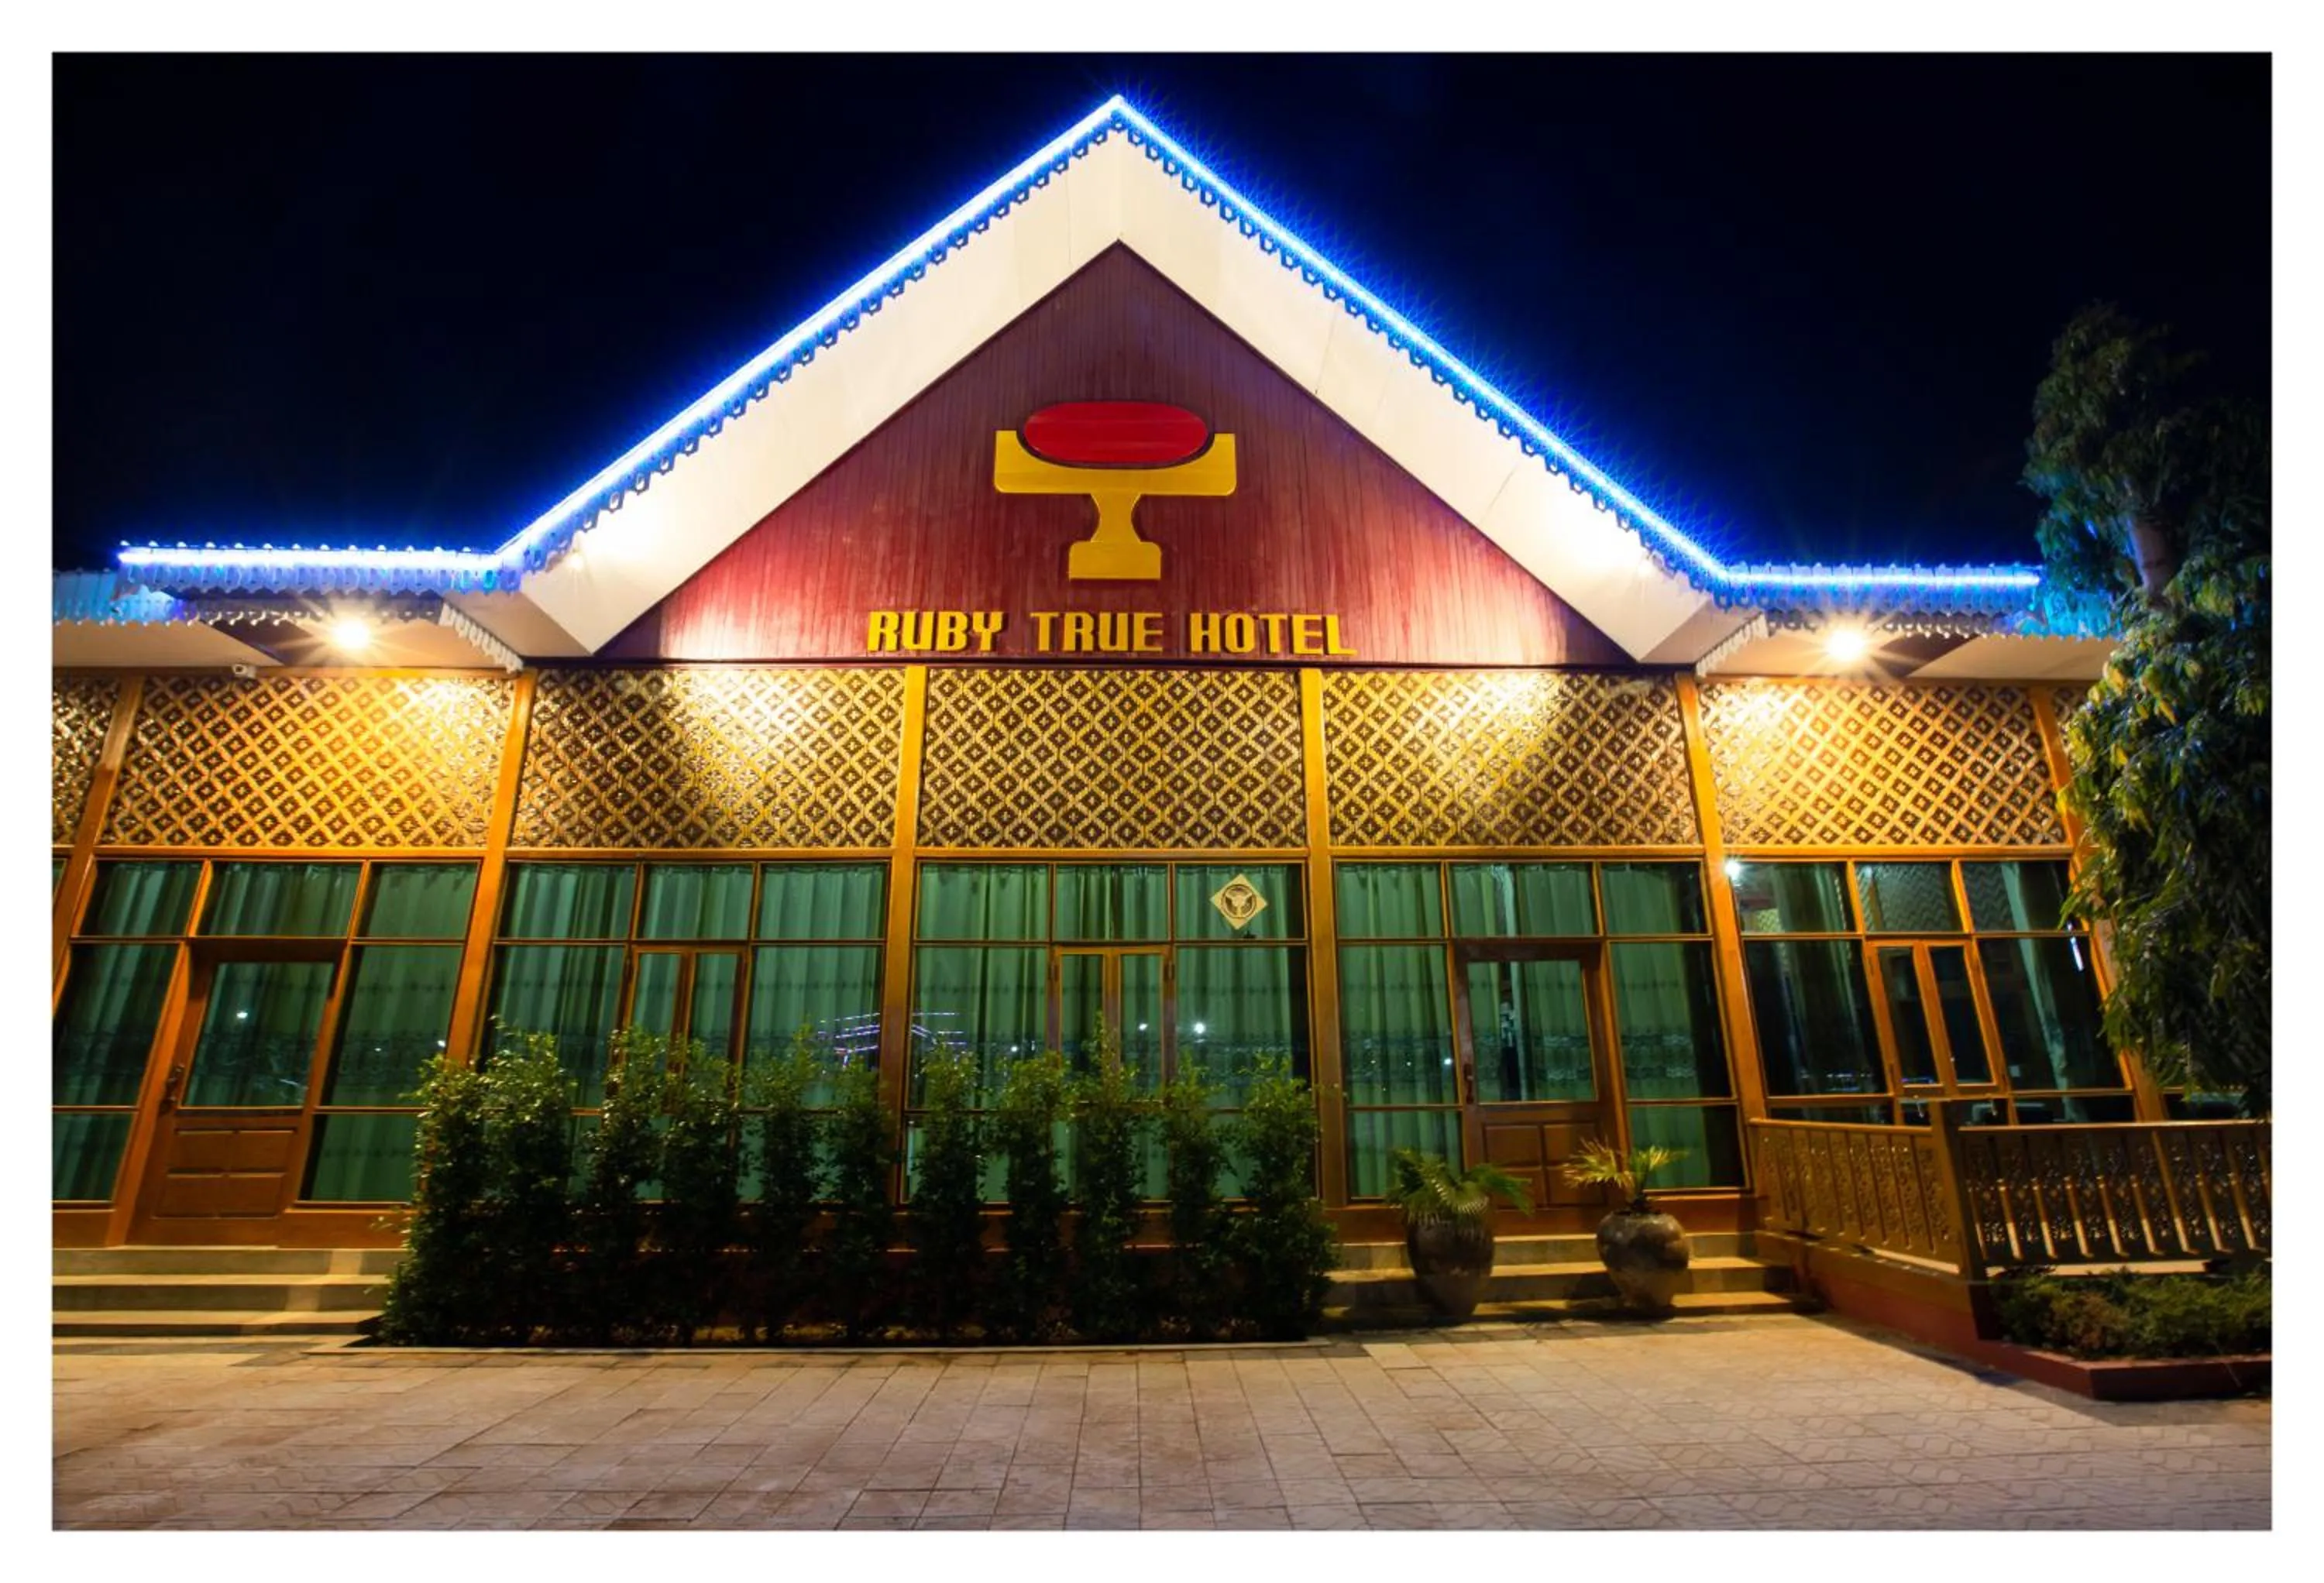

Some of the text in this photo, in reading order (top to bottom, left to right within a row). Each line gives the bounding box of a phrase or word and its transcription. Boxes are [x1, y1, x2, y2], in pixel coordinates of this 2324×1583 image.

[867, 610, 1357, 656] RUBY TRUE HOTEL
